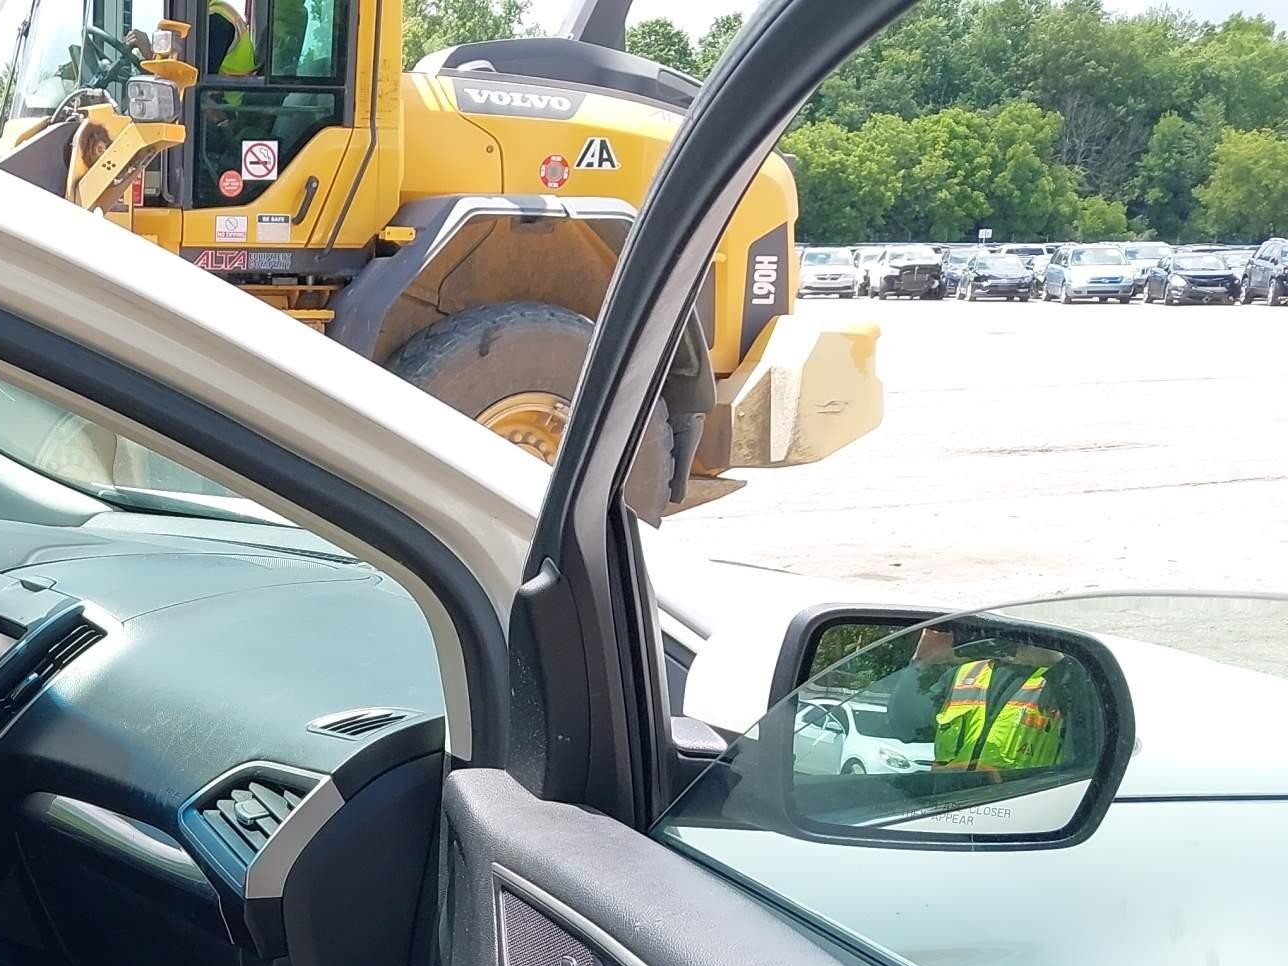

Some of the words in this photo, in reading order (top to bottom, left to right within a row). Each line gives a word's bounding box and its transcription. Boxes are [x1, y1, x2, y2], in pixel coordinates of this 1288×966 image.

[463, 88, 571, 112] VOLVO
[193, 250, 248, 271] ALTA
[752, 255, 778, 305] L90H
[969, 806, 1011, 819] CLOSER
